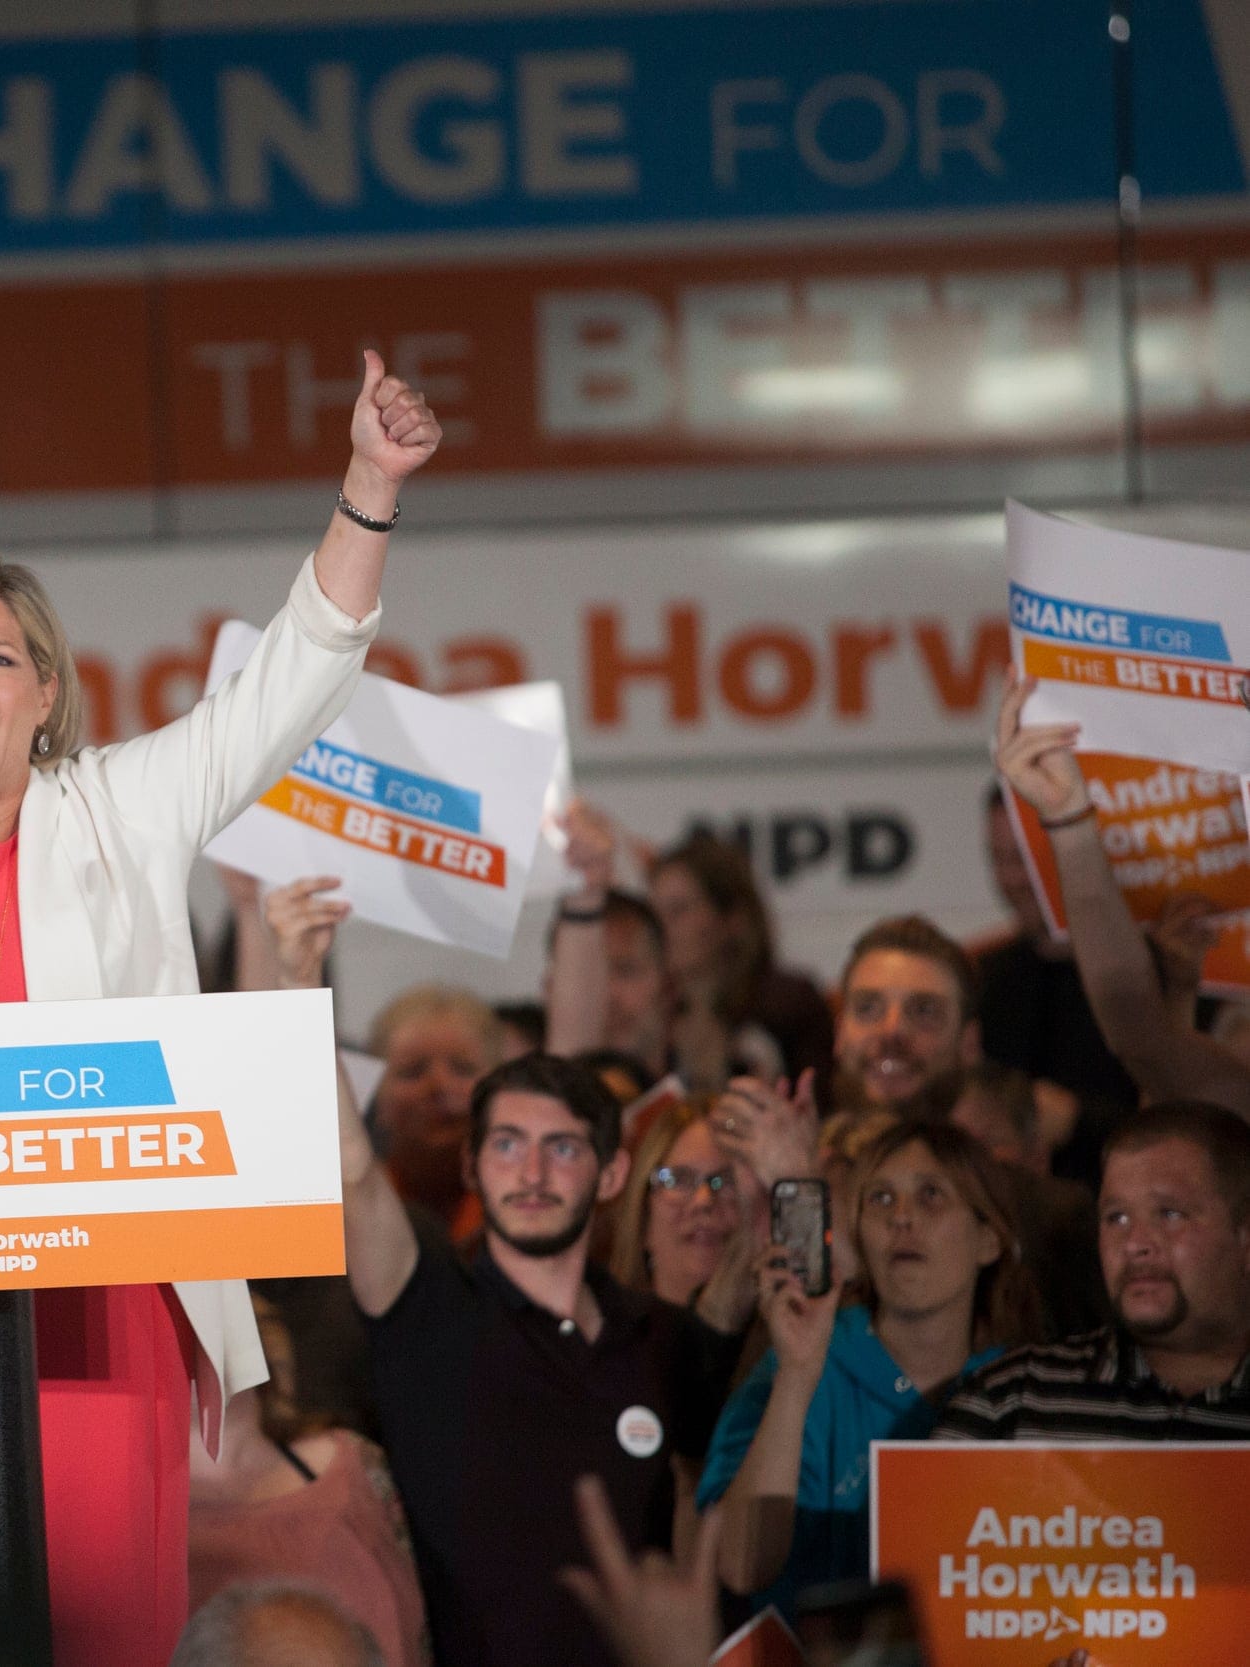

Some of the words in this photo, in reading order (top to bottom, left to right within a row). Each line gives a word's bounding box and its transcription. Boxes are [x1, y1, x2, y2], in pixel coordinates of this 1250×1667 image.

[708, 68, 1010, 188] FOR
[192, 330, 474, 452] THE
[1011, 593, 1130, 645] CHANGE
[1140, 623, 1193, 654] FOR
[1057, 655, 1107, 682] THE
[290, 742, 378, 797] NGE
[384, 779, 444, 817] FOR
[287, 791, 336, 830] THE
[342, 805, 493, 879] BETTER
[19, 1067, 106, 1100] FOR
[965, 1505, 1165, 1548] Andrea
[938, 1552, 1196, 1599] Horwath
[964, 1608, 1049, 1640] NDP
[1083, 1608, 1169, 1639] NPD
